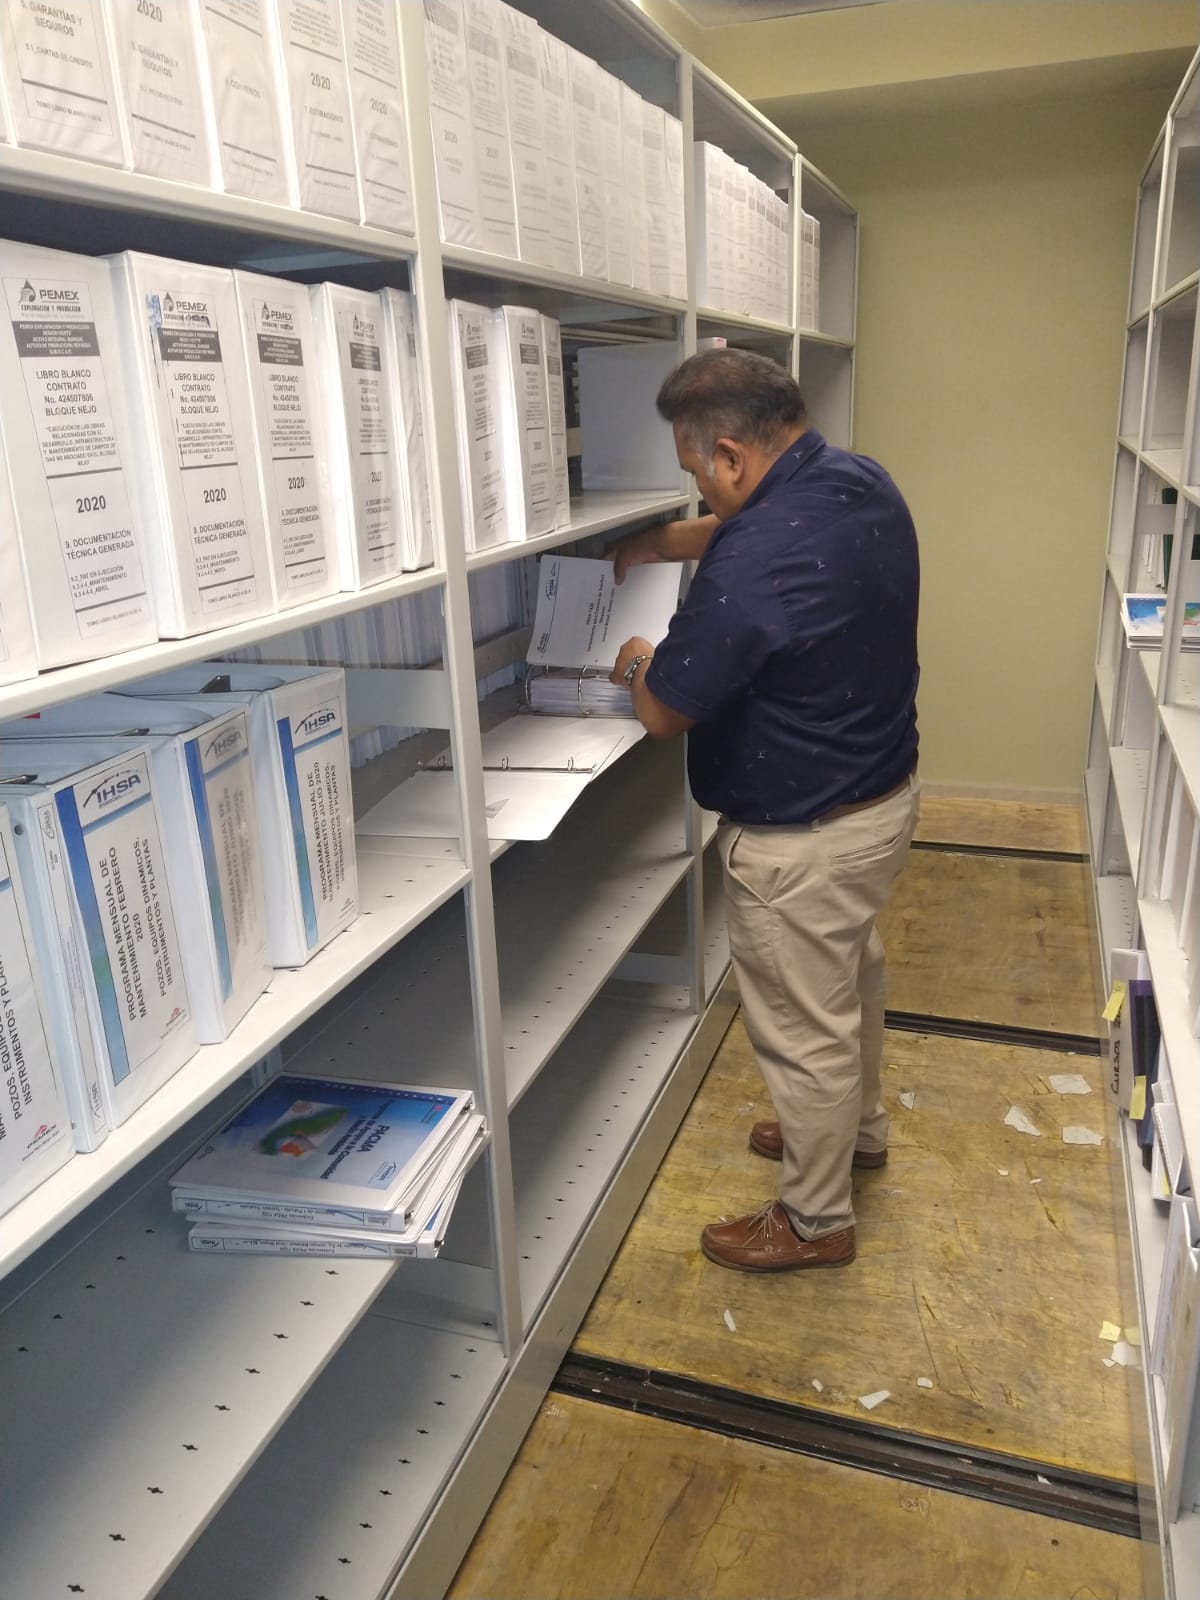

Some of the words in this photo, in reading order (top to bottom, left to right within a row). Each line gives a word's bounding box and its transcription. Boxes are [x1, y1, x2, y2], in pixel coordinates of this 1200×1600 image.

[136, 0, 163, 22] 2020
[35, 16, 74, 37] SEGUROS
[310, 71, 331, 91] 2020
[39, 289, 79, 301] PEMEX
[176, 300, 208, 312] PEMEX
[271, 310, 292, 321] PEMEX
[35, 369, 60, 379] LIBRO
[61, 368, 92, 378] BLANCO
[174, 372, 192, 381] LIBRO
[192, 372, 215, 381] BLANCO
[46, 380, 87, 392] CONTRATO
[182, 384, 211, 392] CONTRATO
[44, 394, 56, 404] No.
[57, 392, 94, 403] 424507806
[45, 405, 77, 416] BLOQUE
[77, 404, 97, 414] NEJO
[181, 405, 204, 415] BLOQUE
[205, 404, 219, 413] NEJO
[288, 476, 305, 489] 2020
[76, 494, 107, 513] 2020
[203, 487, 227, 503] 2020
[199, 518, 244, 533] DOCUMENTACIÓN
[219, 528, 246, 540] GENERADA
[65, 540, 72, 549] 9.
[73, 527, 131, 548] DOCUMENTACIÓN
[66, 544, 97, 561] TÉCNICA
[98, 537, 134, 554] GENERADA
[304, 712, 336, 732] IHSA
[214, 731, 242, 754] IHSA
[96, 774, 141, 803] IHSA
[307, 772, 314, 788] DE
[317, 787, 325, 816] JULIO
[310, 791, 321, 839] MENSUAL
[99, 857, 109, 878] DE
[142, 839, 155, 890] PLANTAS
[316, 840, 327, 901] PROGRAMA
[320, 819, 333, 902] MANTENIMIENTO
[108, 847, 127, 911] FEBRERO
[152, 893, 158, 901] Y
[104, 879, 122, 944] MENSUAL
[132, 912, 143, 942] 2020
[145, 905, 160, 955] EQUIPOS
[154, 901, 173, 986] INSTRUMENTOS
[121, 913, 147, 1018] MANTENIMIENTO
[117, 945, 137, 1020] PROGRAMA
[156, 956, 167, 997] POZOS,
[3, 999, 11, 1008] Y
[6, 1008, 32, 1105] INSTRUMENTOS
[7, 1072, 22, 1120] POZOS,
[363, 1124, 390, 1153] PACMA
